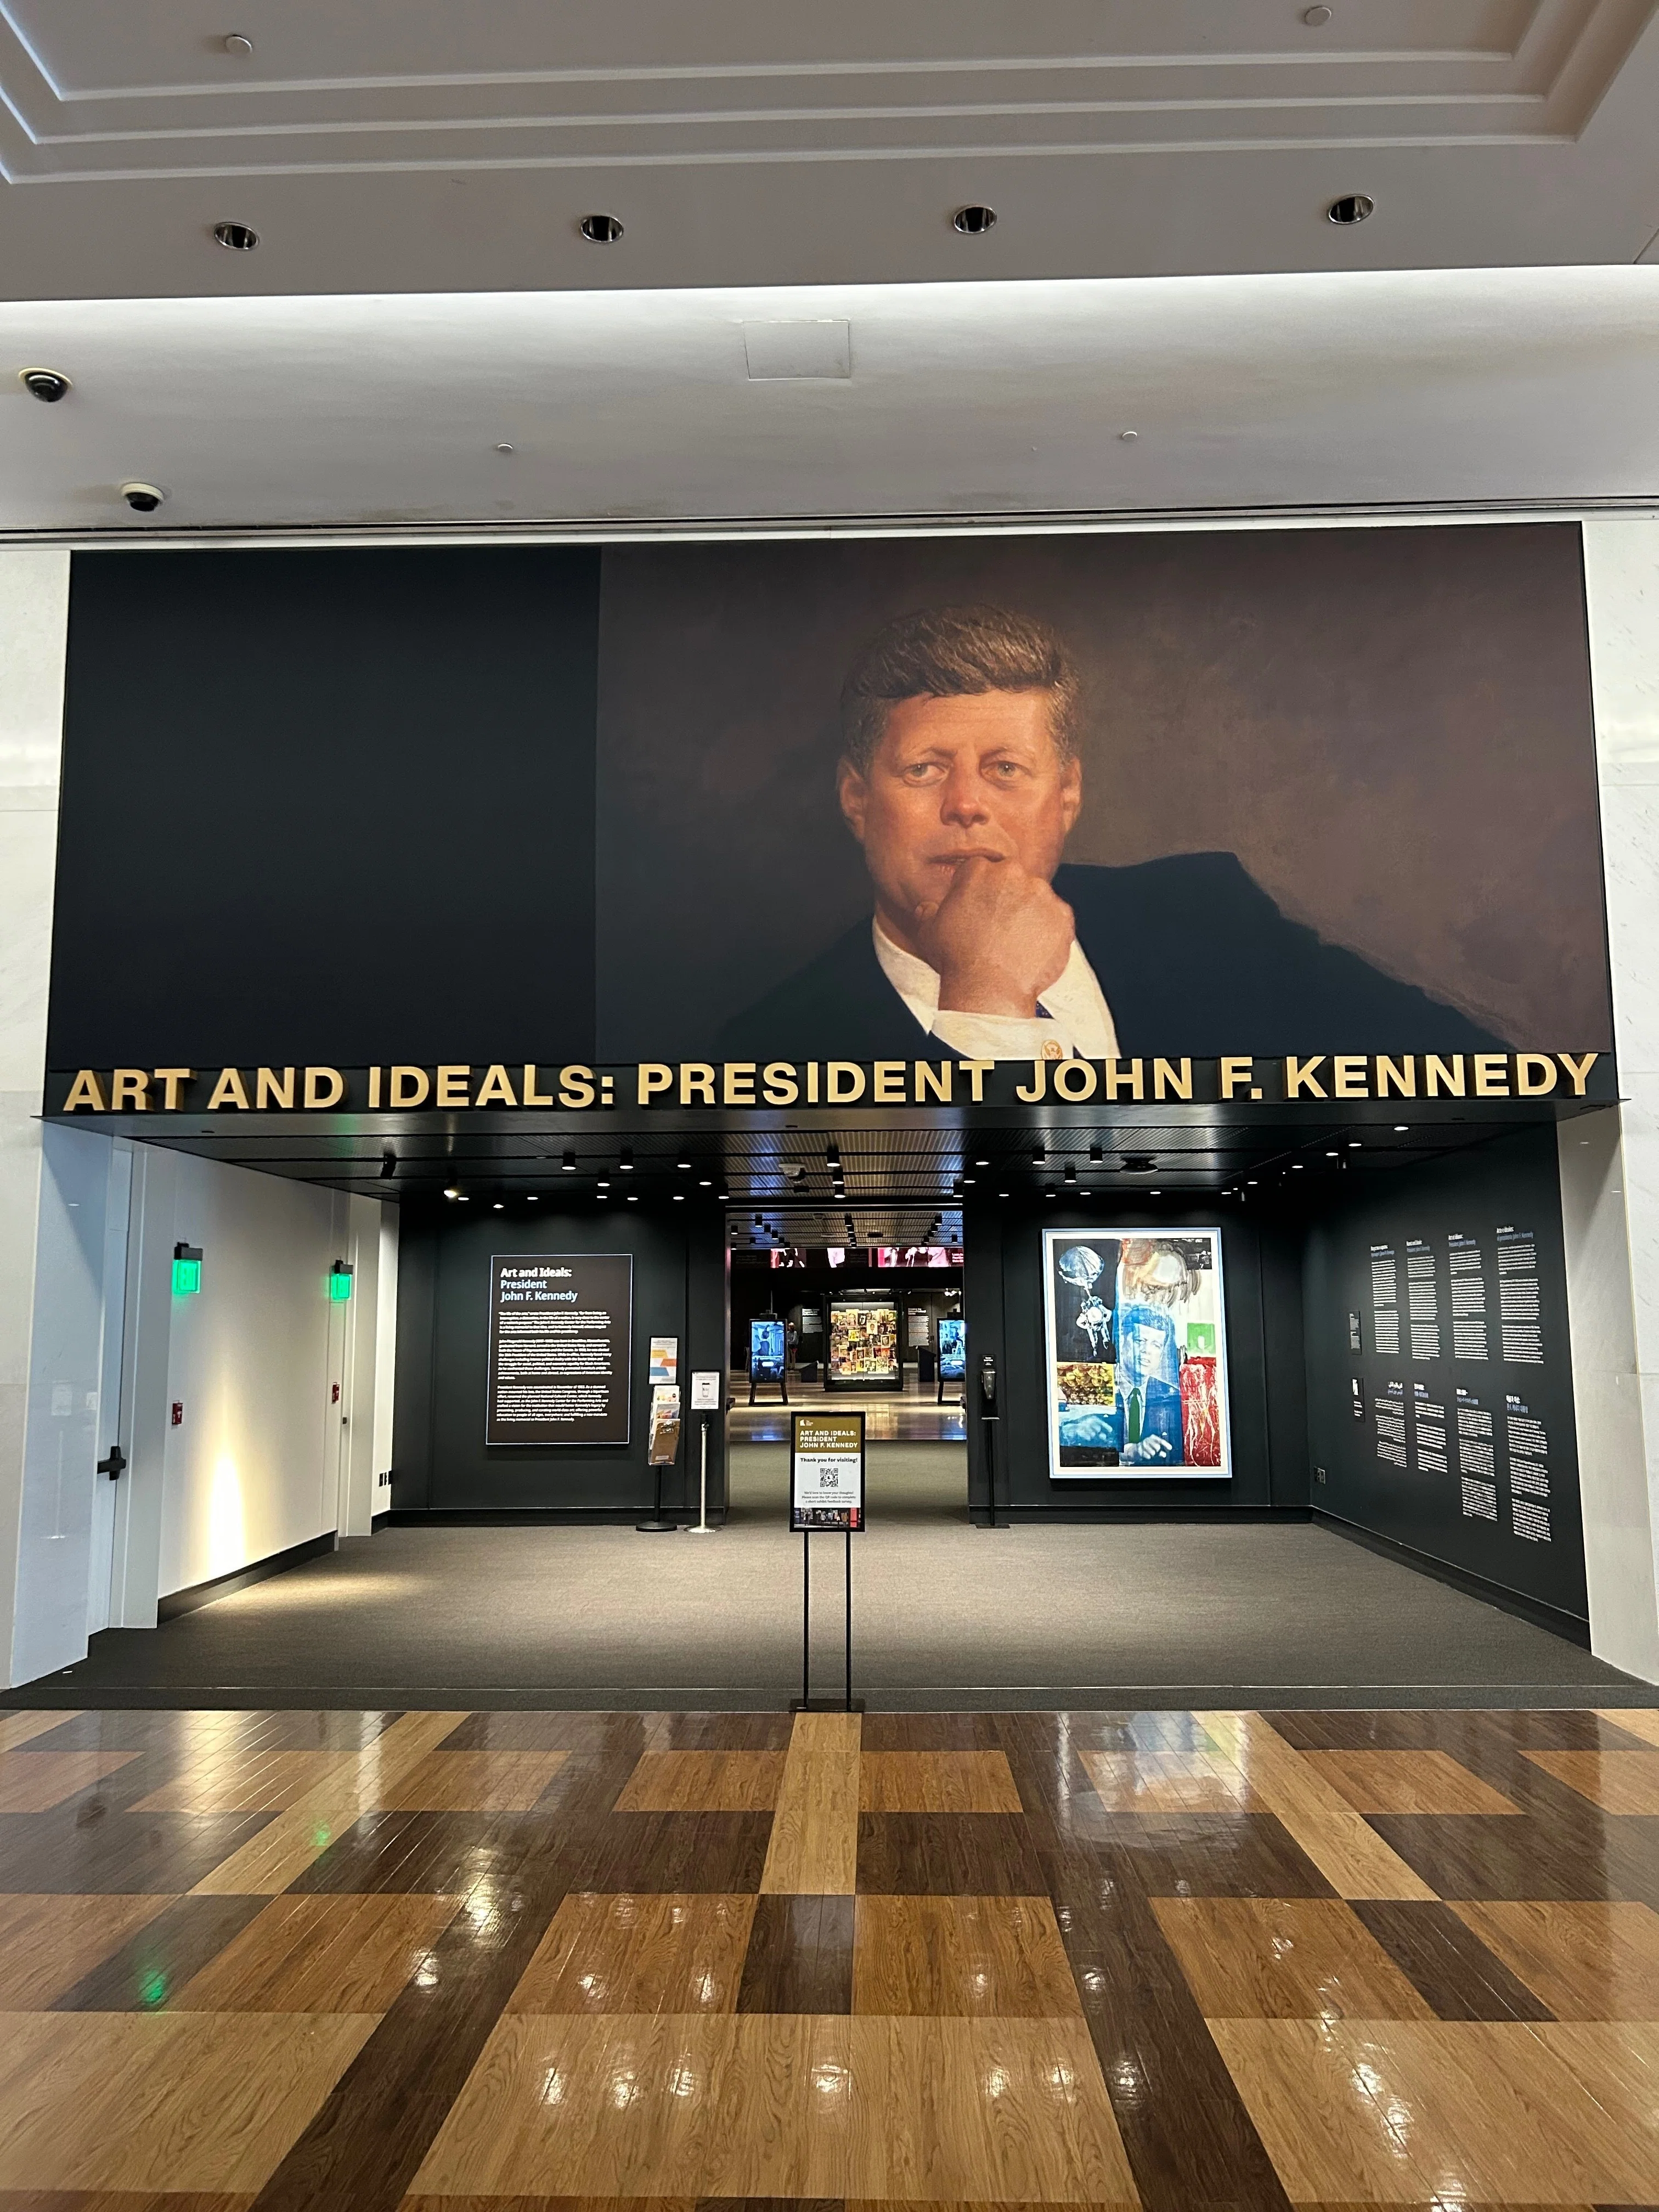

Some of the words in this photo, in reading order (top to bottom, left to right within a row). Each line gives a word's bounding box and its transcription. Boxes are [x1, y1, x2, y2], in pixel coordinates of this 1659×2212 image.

[63, 1069, 193, 1111] ART
[207, 1066, 345, 1109] AND
[368, 1064, 614, 1108] IDEALS:
[637, 1060, 995, 1105] PRESIDENT
[1015, 1057, 1193, 1103] JOHN
[1221, 1057, 1263, 1100] F.
[1285, 1052, 1599, 1099] KENNEDY
[500, 1267, 518, 1278] Art
[518, 1267, 538, 1277] and
[539, 1267, 572, 1277] Ideals:
[500, 1279, 548, 1289] President
[500, 1290, 523, 1303] John
[526, 1291, 533, 1300] F.
[535, 1290, 578, 1303] Kennedy
